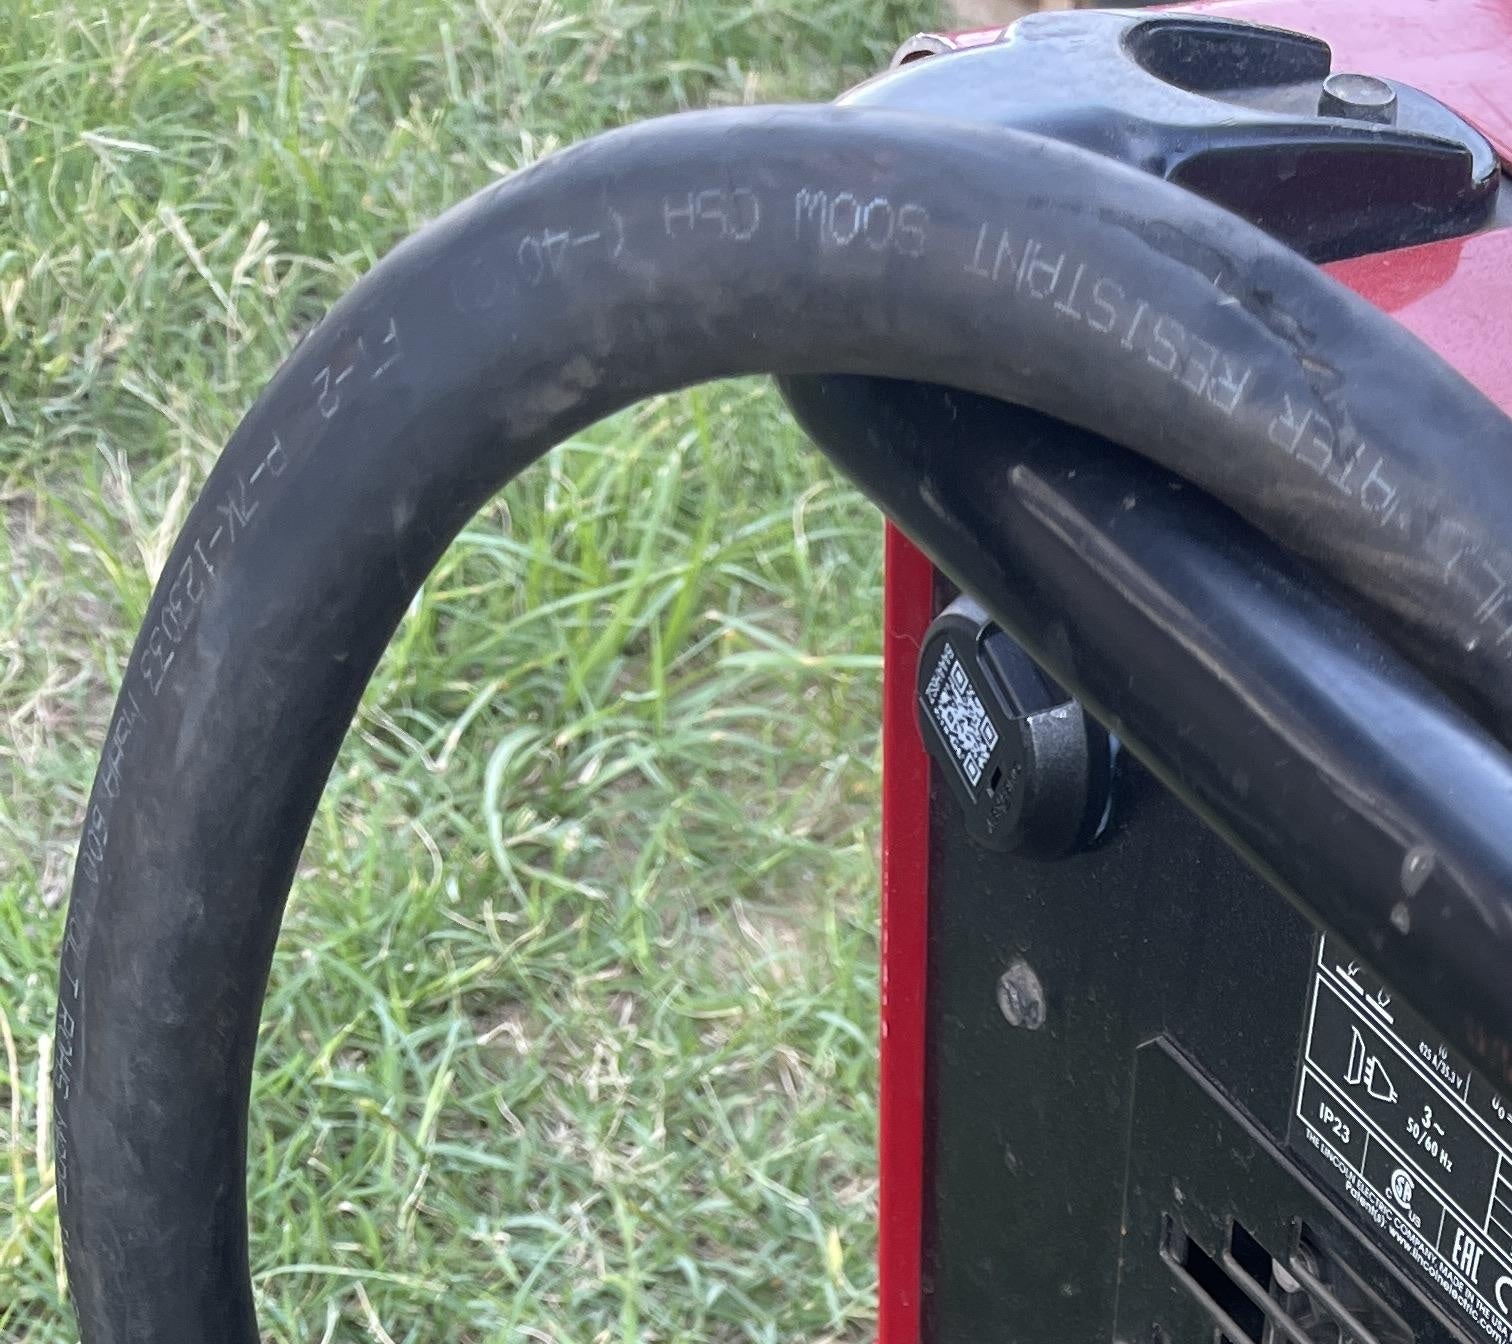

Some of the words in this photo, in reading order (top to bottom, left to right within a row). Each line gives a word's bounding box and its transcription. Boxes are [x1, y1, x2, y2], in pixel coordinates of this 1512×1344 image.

[963, 221, 1252, 417] RESISTANT
[1319, 1102, 1350, 1143] IP23
[1406, 1117, 1438, 1157] 50/60
[1439, 1148, 1452, 1172] Hz
[1345, 1180, 1386, 1228] Patent(s):
[1306, 1127, 1319, 1148] THE
[1320, 1143, 1356, 1183] LINCOLN
[1356, 1179, 1392, 1220] ELECTRIC
[1393, 1217, 1436, 1263] COMPANY,
[1438, 1262, 1464, 1292] MADE
[1464, 1287, 1475, 1303] IN
[1475, 1298, 1490, 1319] THE
[1490, 1314, 1507, 1337] USA
